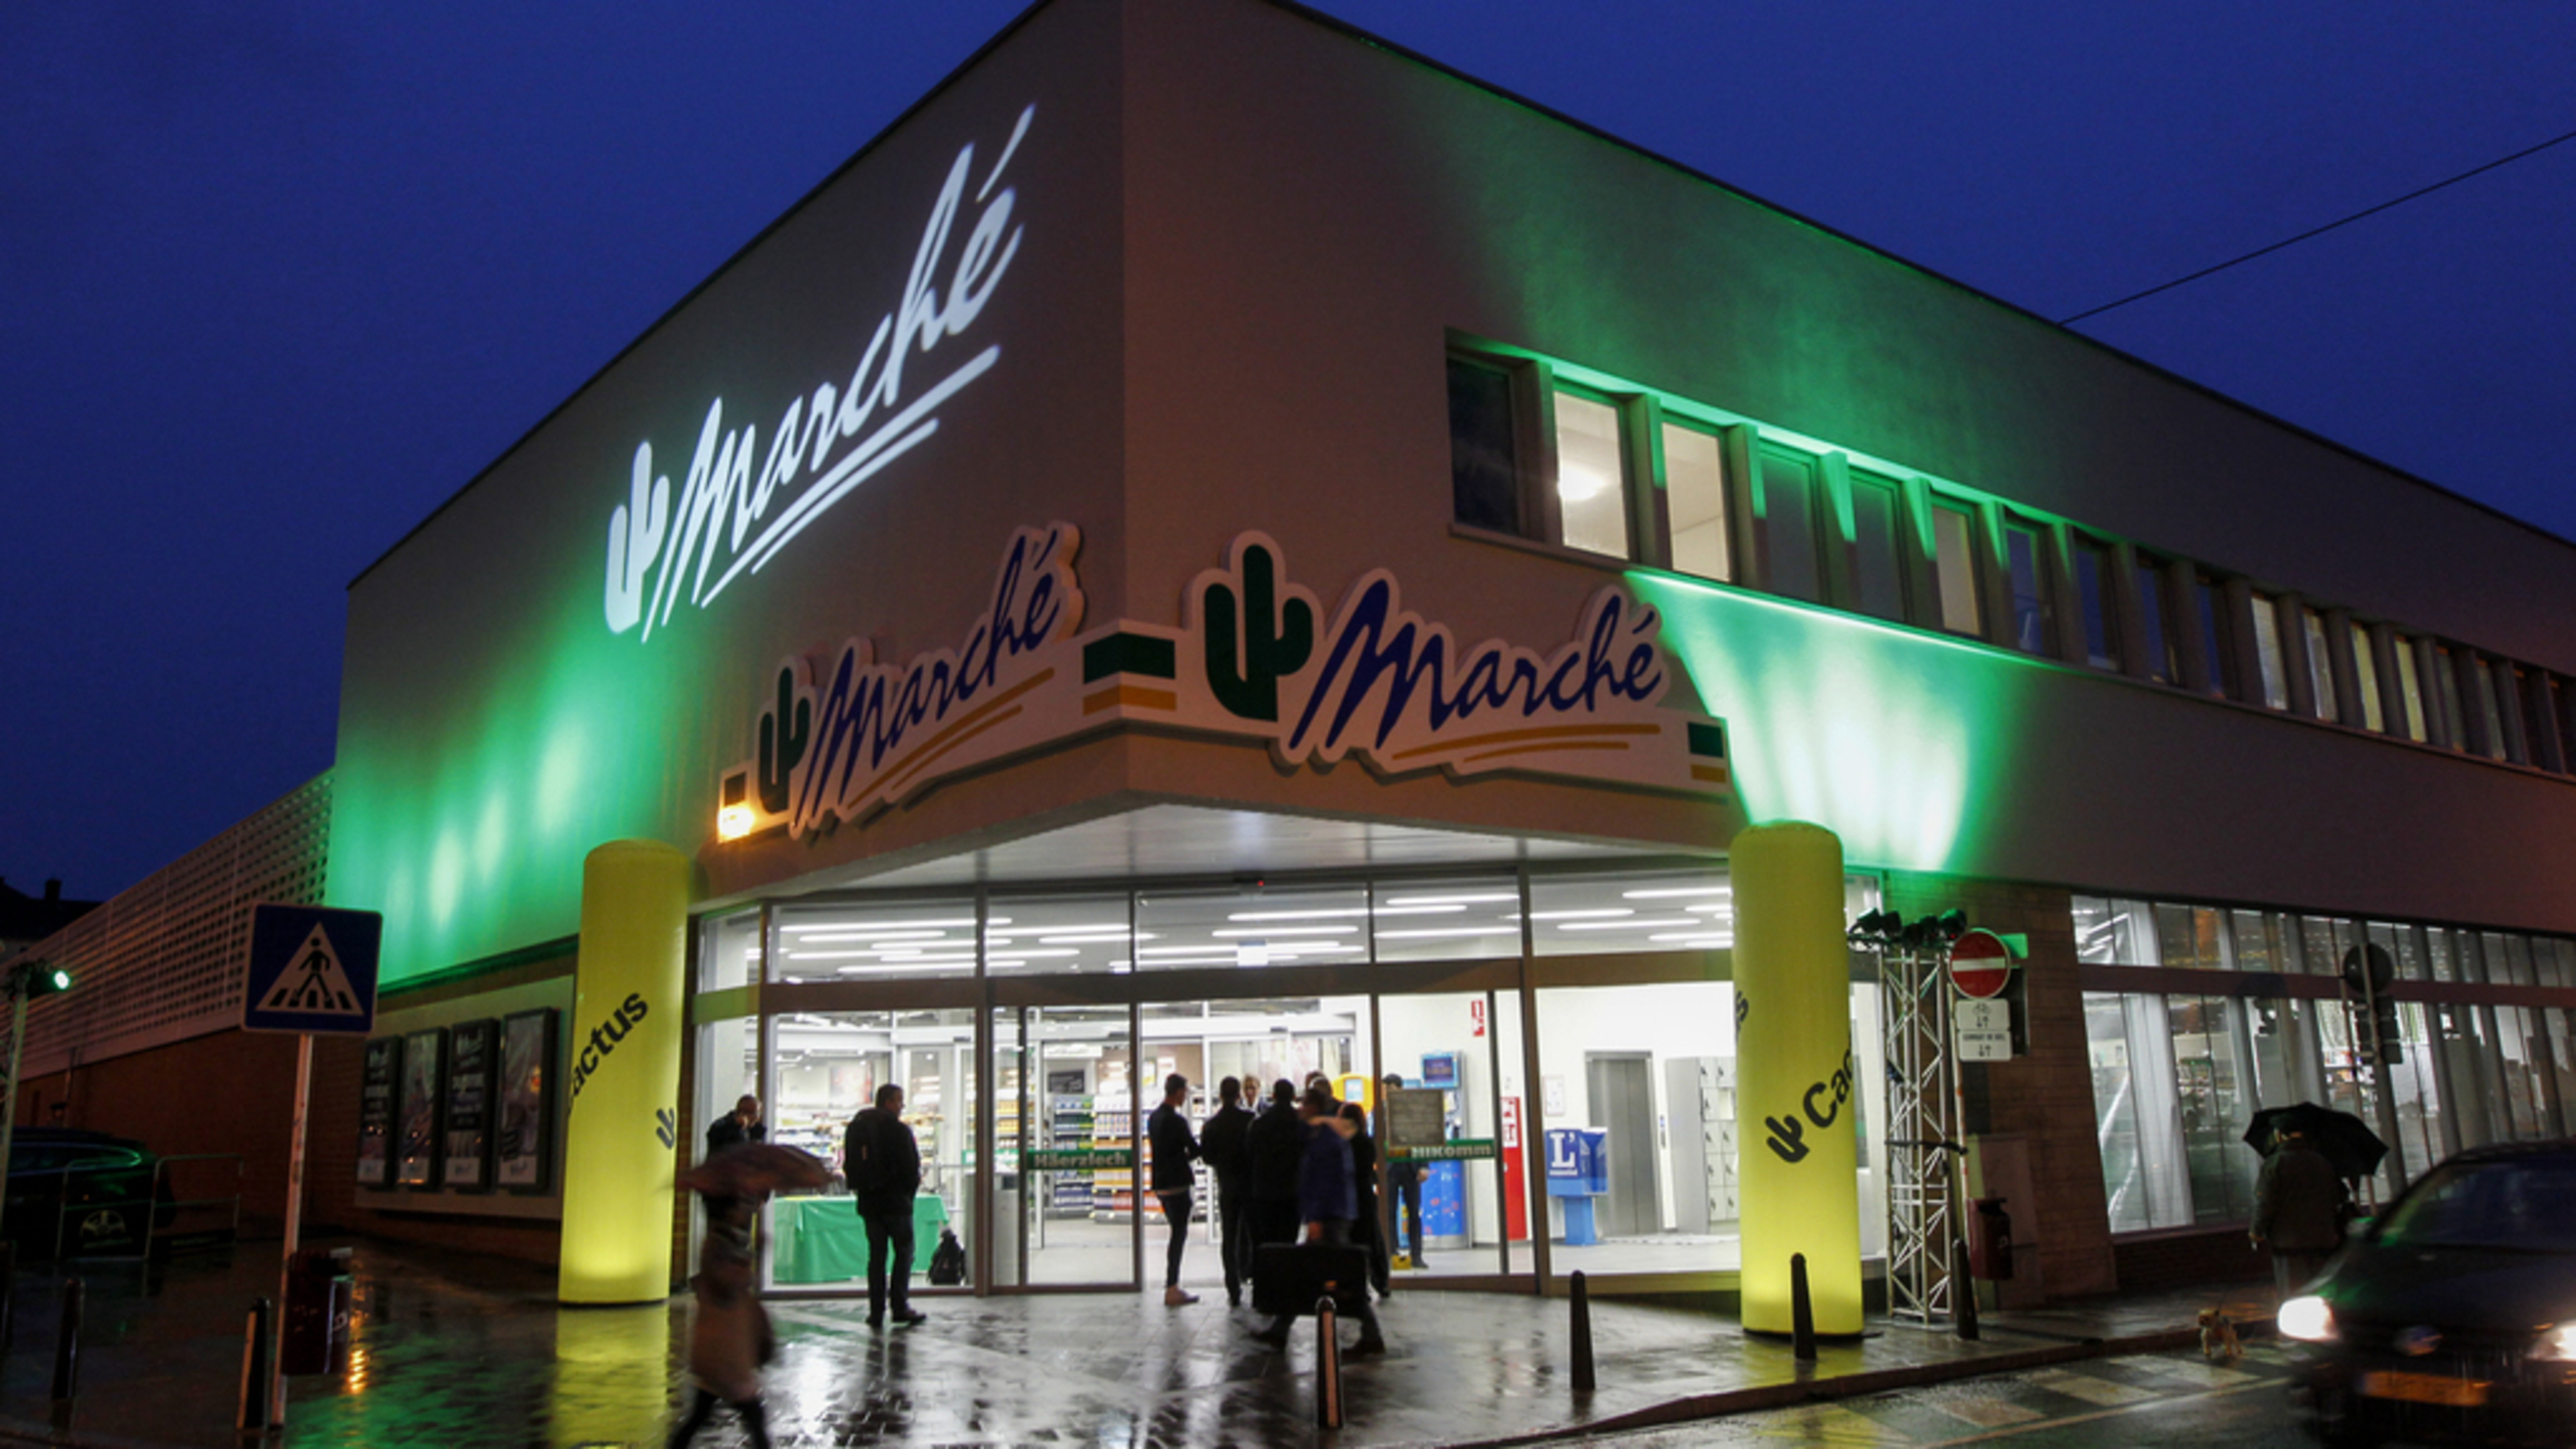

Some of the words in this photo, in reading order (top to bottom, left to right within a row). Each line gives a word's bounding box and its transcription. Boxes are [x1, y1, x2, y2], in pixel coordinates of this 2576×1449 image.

[642, 103, 1036, 643] Marché
[794, 529, 1061, 828] Marché
[1289, 578, 1662, 751] Marché
[571, 992, 649, 1099] actus
